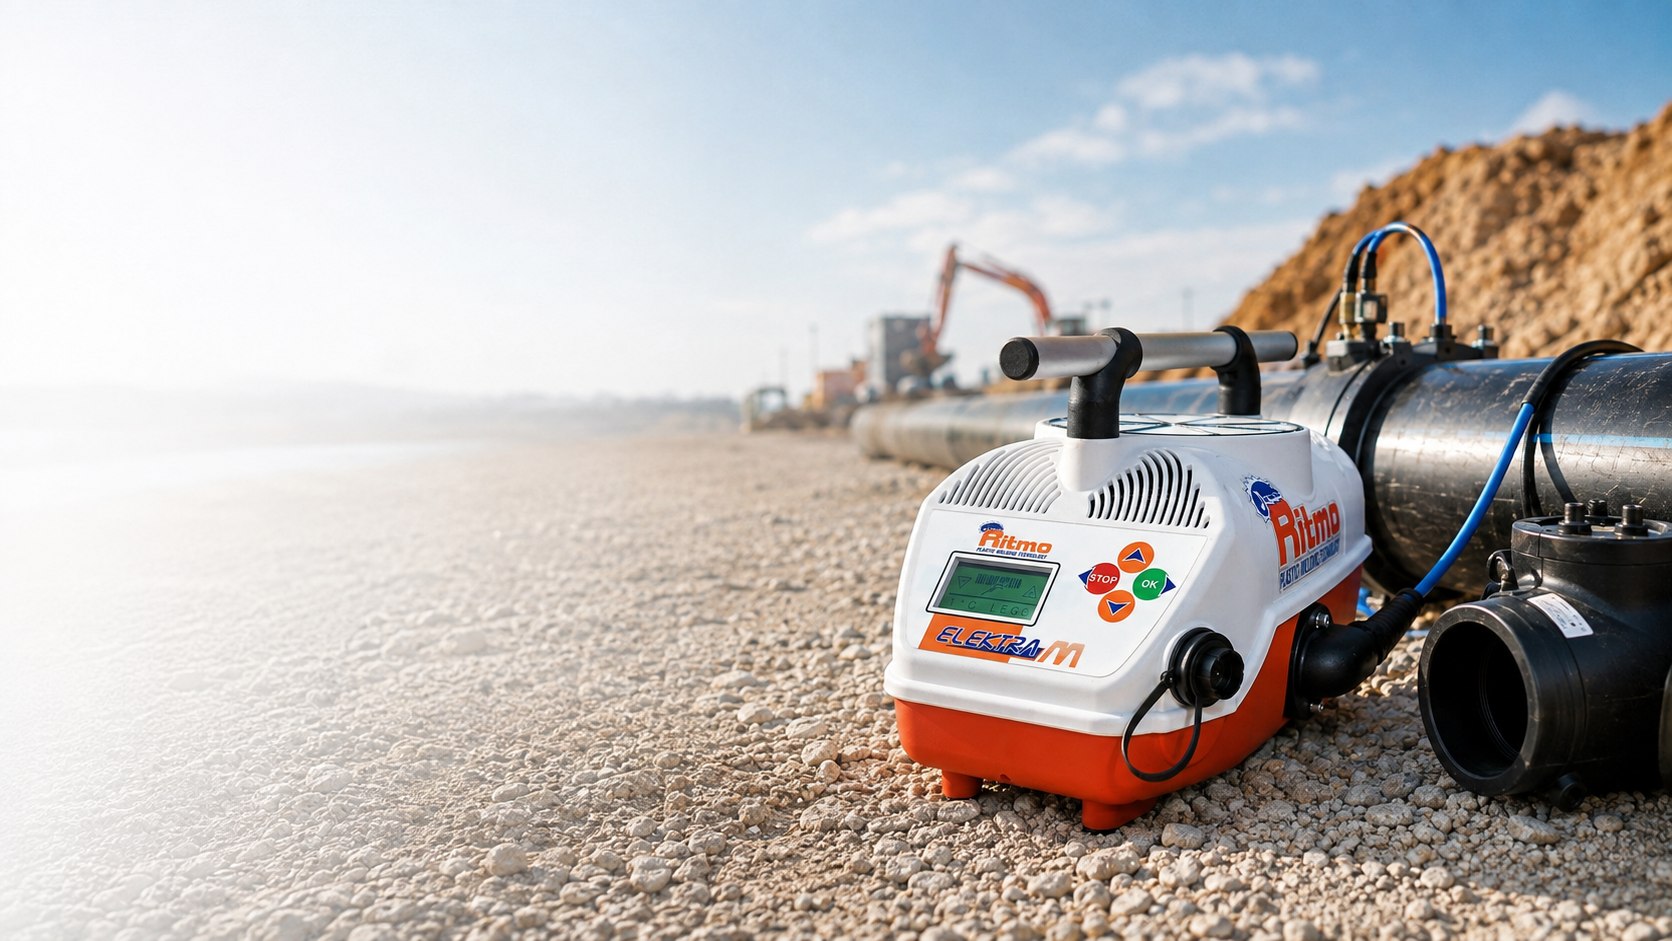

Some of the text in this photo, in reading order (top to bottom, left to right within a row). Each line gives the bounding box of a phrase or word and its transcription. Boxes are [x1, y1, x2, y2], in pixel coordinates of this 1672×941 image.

[979, 529, 1053, 554] Ritmo
[1268, 498, 1340, 567] Ritmo
[1089, 573, 1118, 584] STOP
[1141, 579, 1159, 589] OK
[936, 626, 1085, 668] ELEKTRA M
